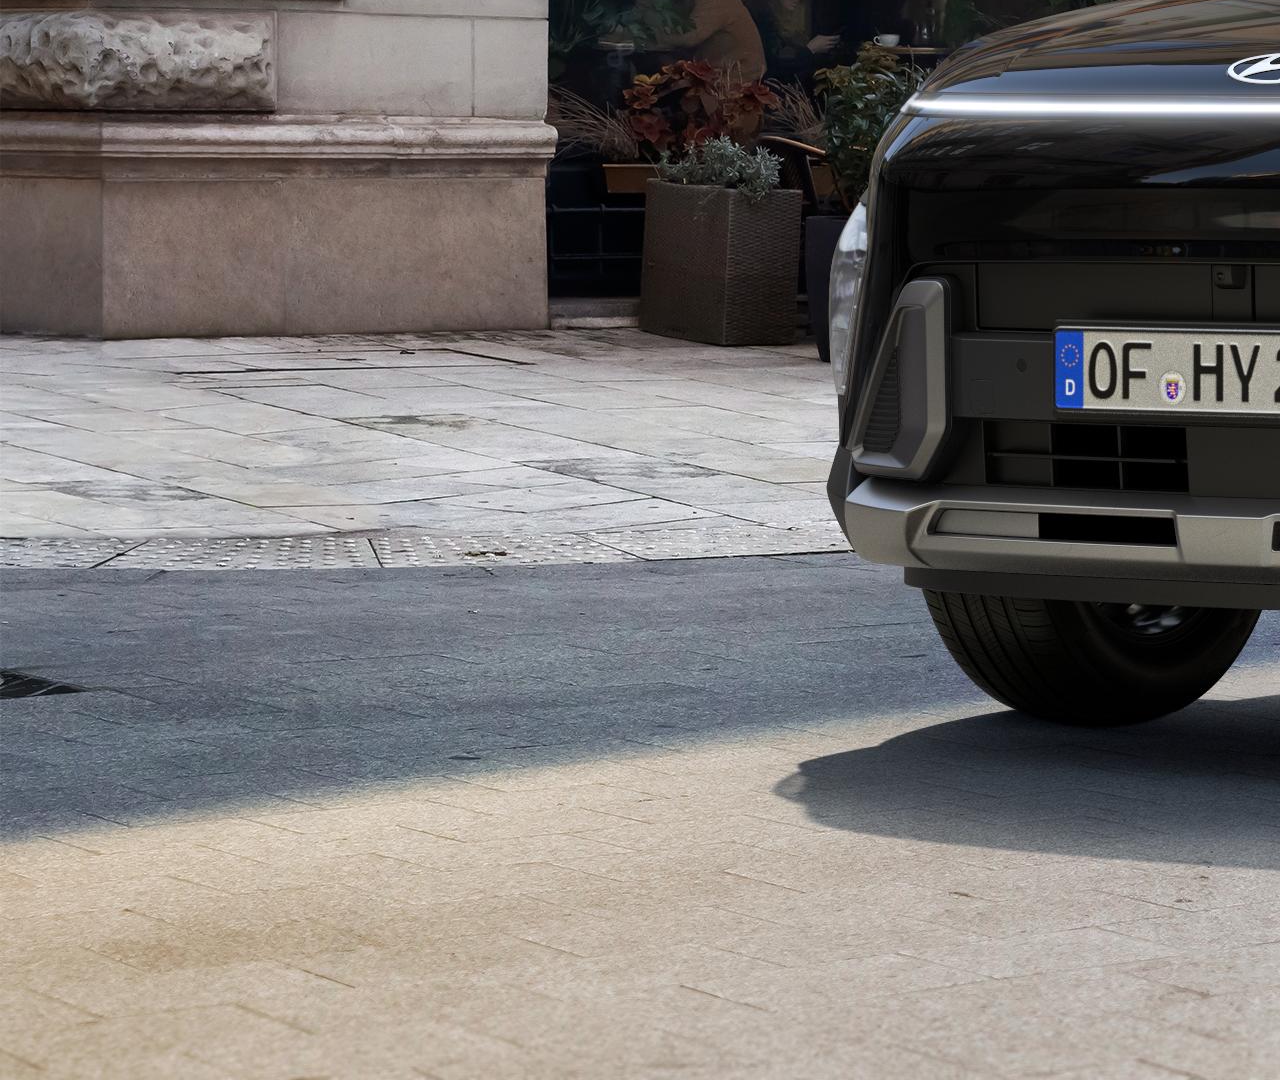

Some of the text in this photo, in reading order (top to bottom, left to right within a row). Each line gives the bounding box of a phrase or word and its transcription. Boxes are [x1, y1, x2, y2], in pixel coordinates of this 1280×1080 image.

[1064, 378, 1076, 397] D
[1088, 341, 1153, 401] OF
[1193, 343, 1261, 404] HY
